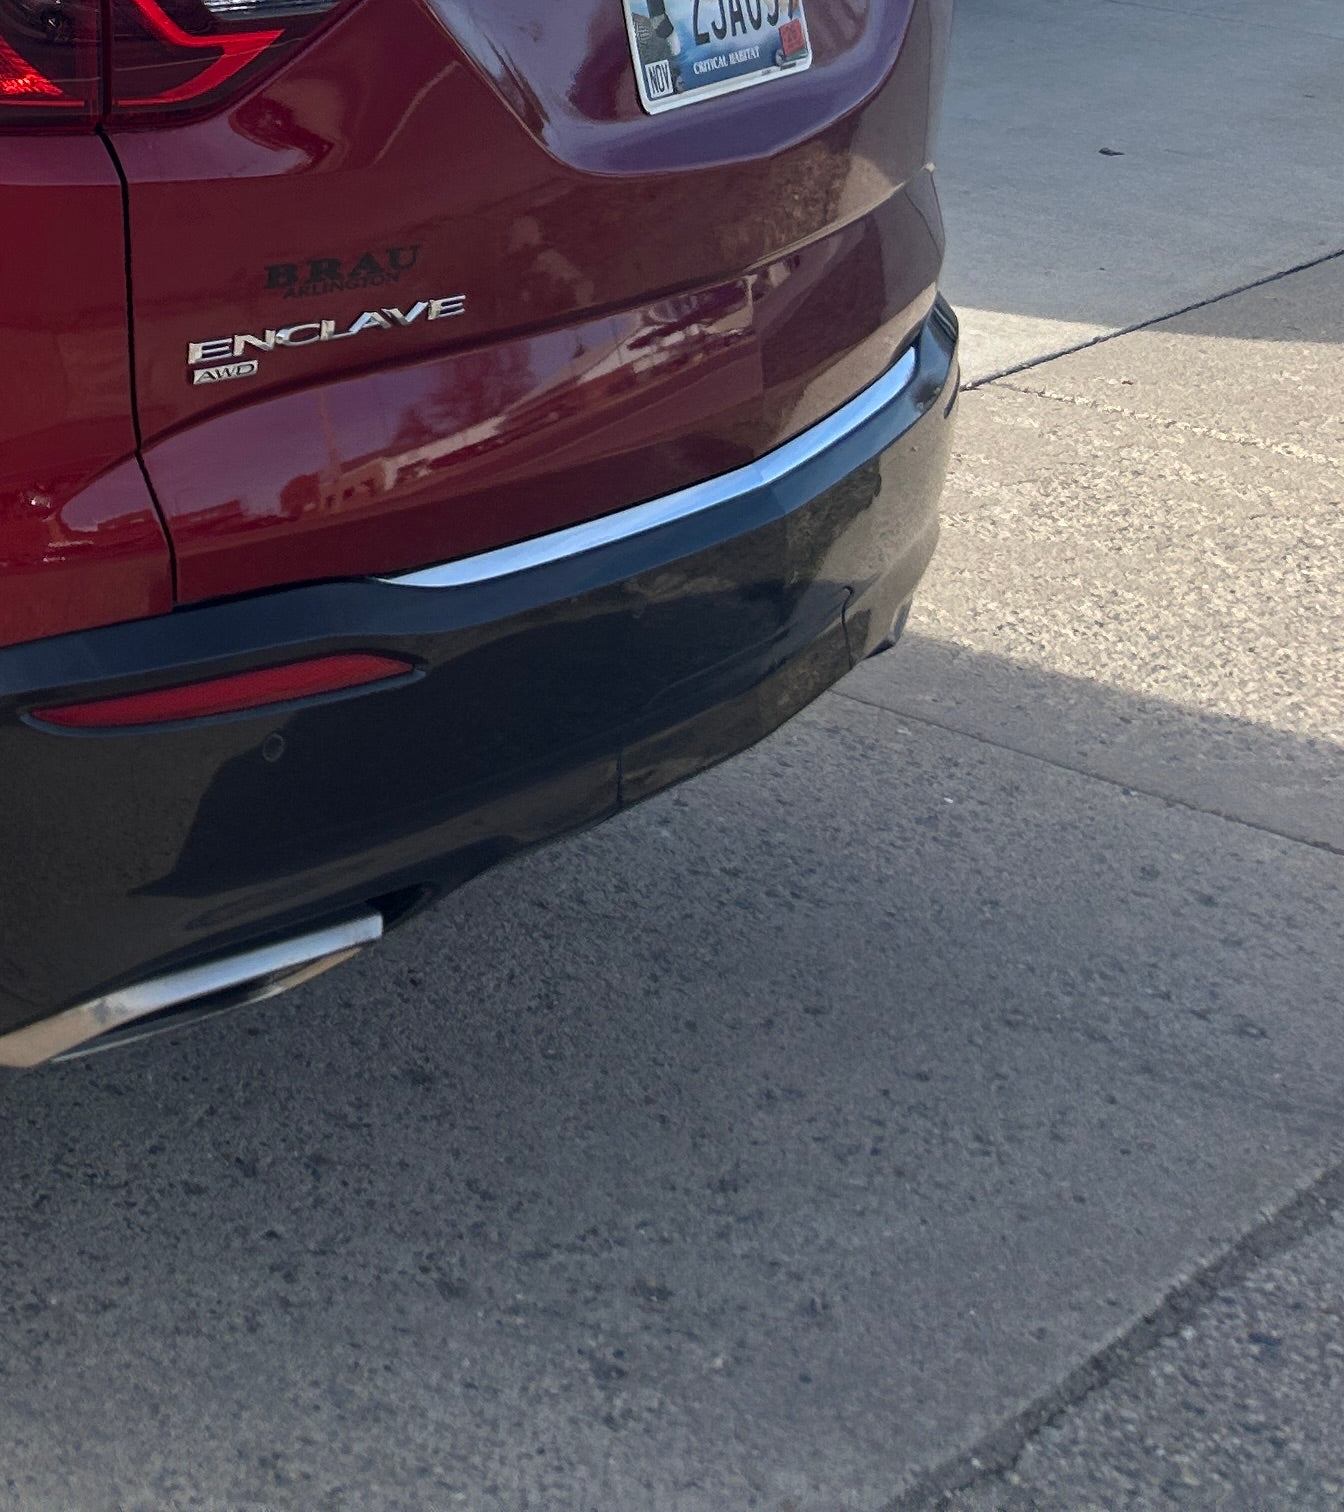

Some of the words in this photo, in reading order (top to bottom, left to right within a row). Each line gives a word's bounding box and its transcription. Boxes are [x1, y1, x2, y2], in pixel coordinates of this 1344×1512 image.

[693, 55, 729, 75] CRITICAL
[264, 245, 420, 289] BRAU
[283, 271, 401, 300] ARLINGTON
[188, 295, 466, 365] ENCLAVE
[195, 362, 256, 384] AWD
